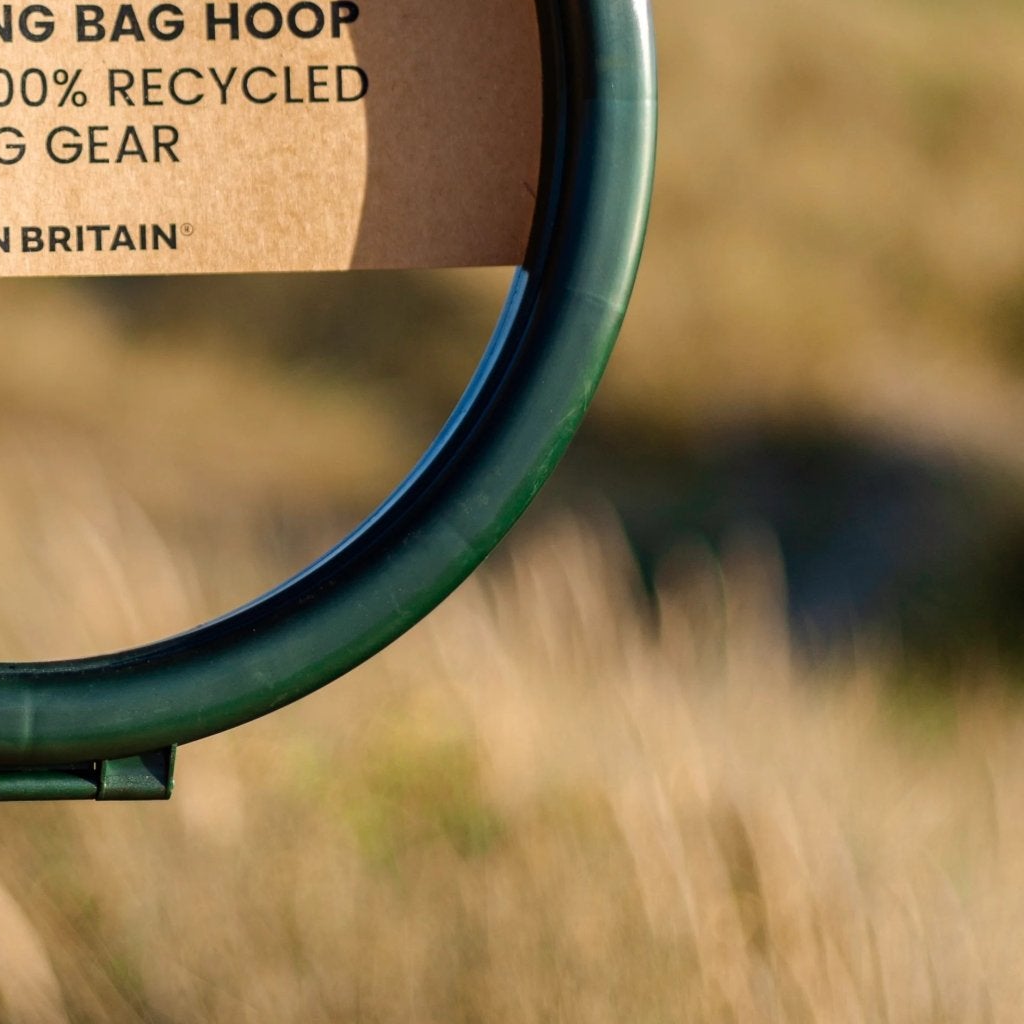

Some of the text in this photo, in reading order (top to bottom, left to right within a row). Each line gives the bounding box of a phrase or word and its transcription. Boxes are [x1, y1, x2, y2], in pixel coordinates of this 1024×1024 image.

[75, 2, 185, 44] BAG
[205, 0, 360, 43] HOOP
[107, 64, 370, 107] RECYCLED
[45, 124, 180, 165] GEAR
